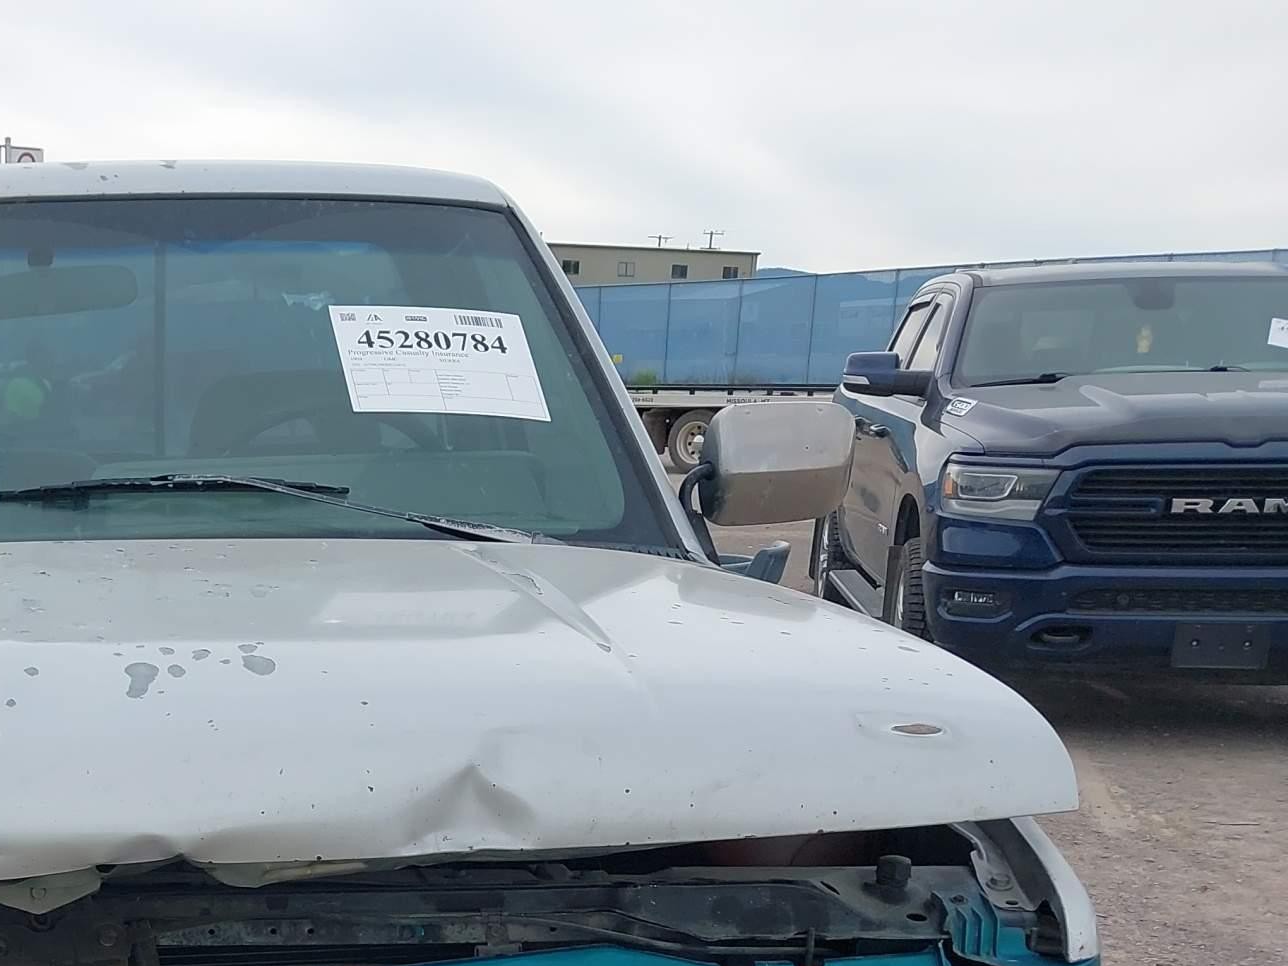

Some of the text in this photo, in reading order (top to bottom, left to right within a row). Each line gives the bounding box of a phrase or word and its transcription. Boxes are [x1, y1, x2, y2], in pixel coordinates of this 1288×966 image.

[357, 329, 508, 354] 45280784
[348, 349, 469, 359] Progressive Casualty Insurance
